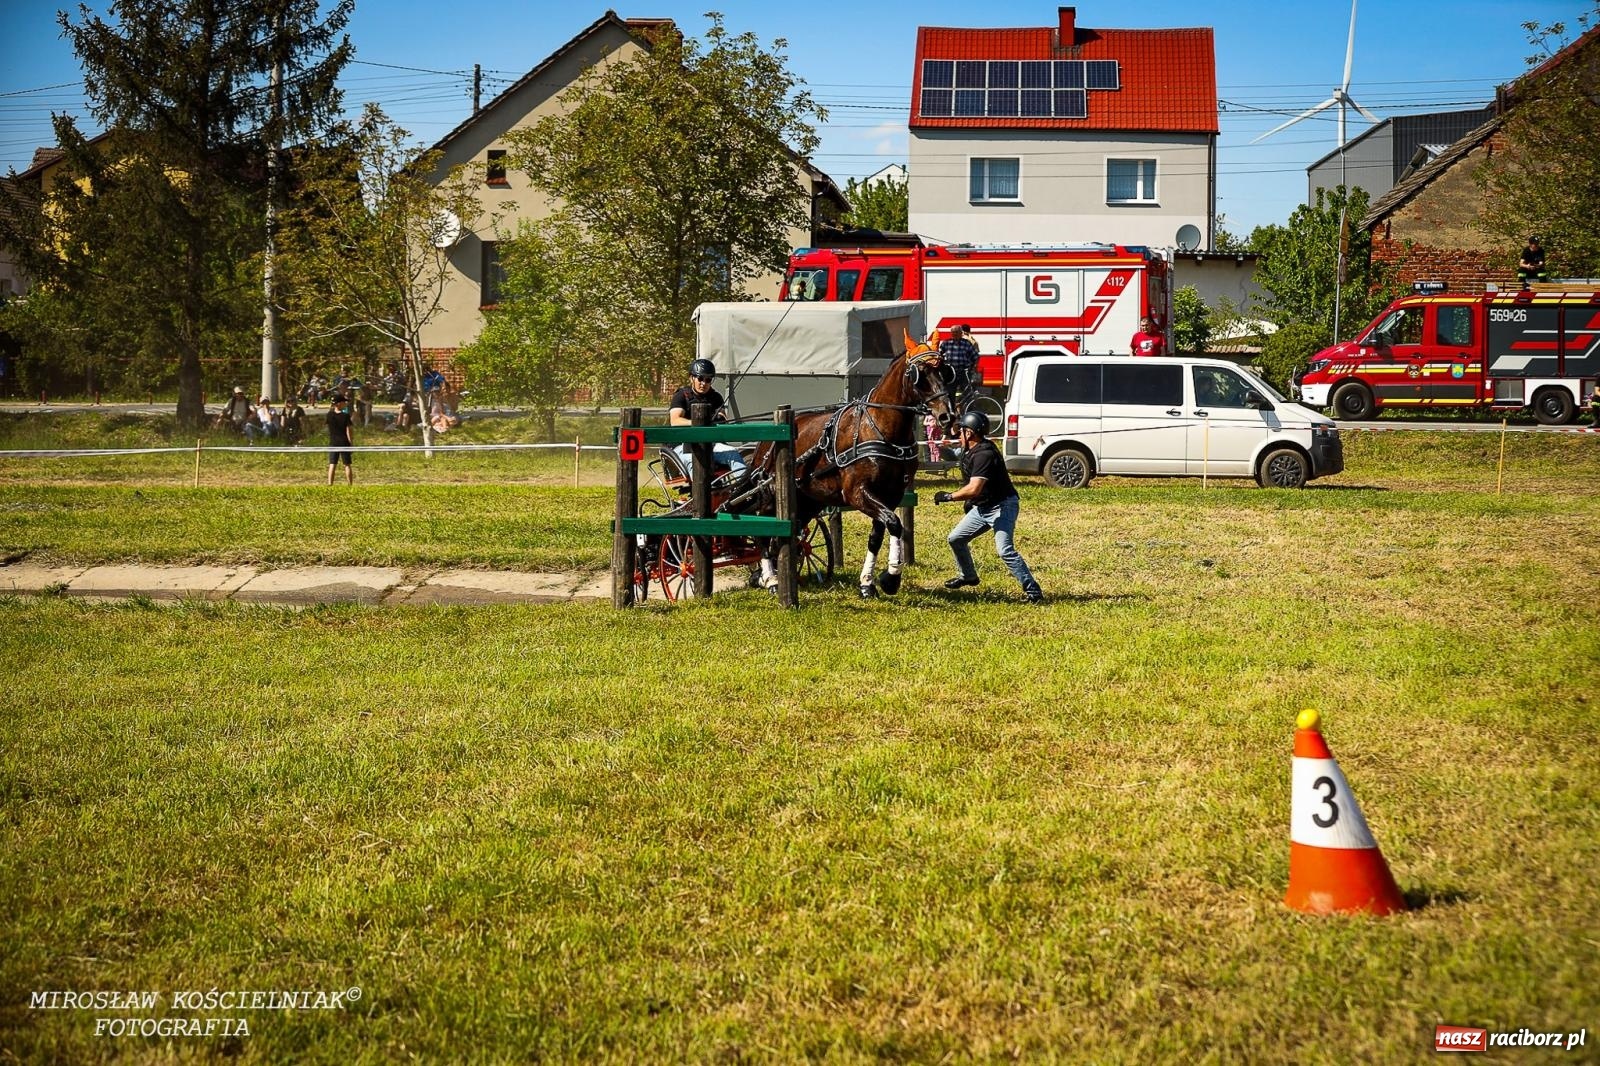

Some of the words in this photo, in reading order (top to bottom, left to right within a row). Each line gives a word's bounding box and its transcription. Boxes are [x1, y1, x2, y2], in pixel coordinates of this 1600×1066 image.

[1111, 276, 1125, 287] 112
[626, 435, 640, 455] D
[1312, 776, 1339, 828] 3
